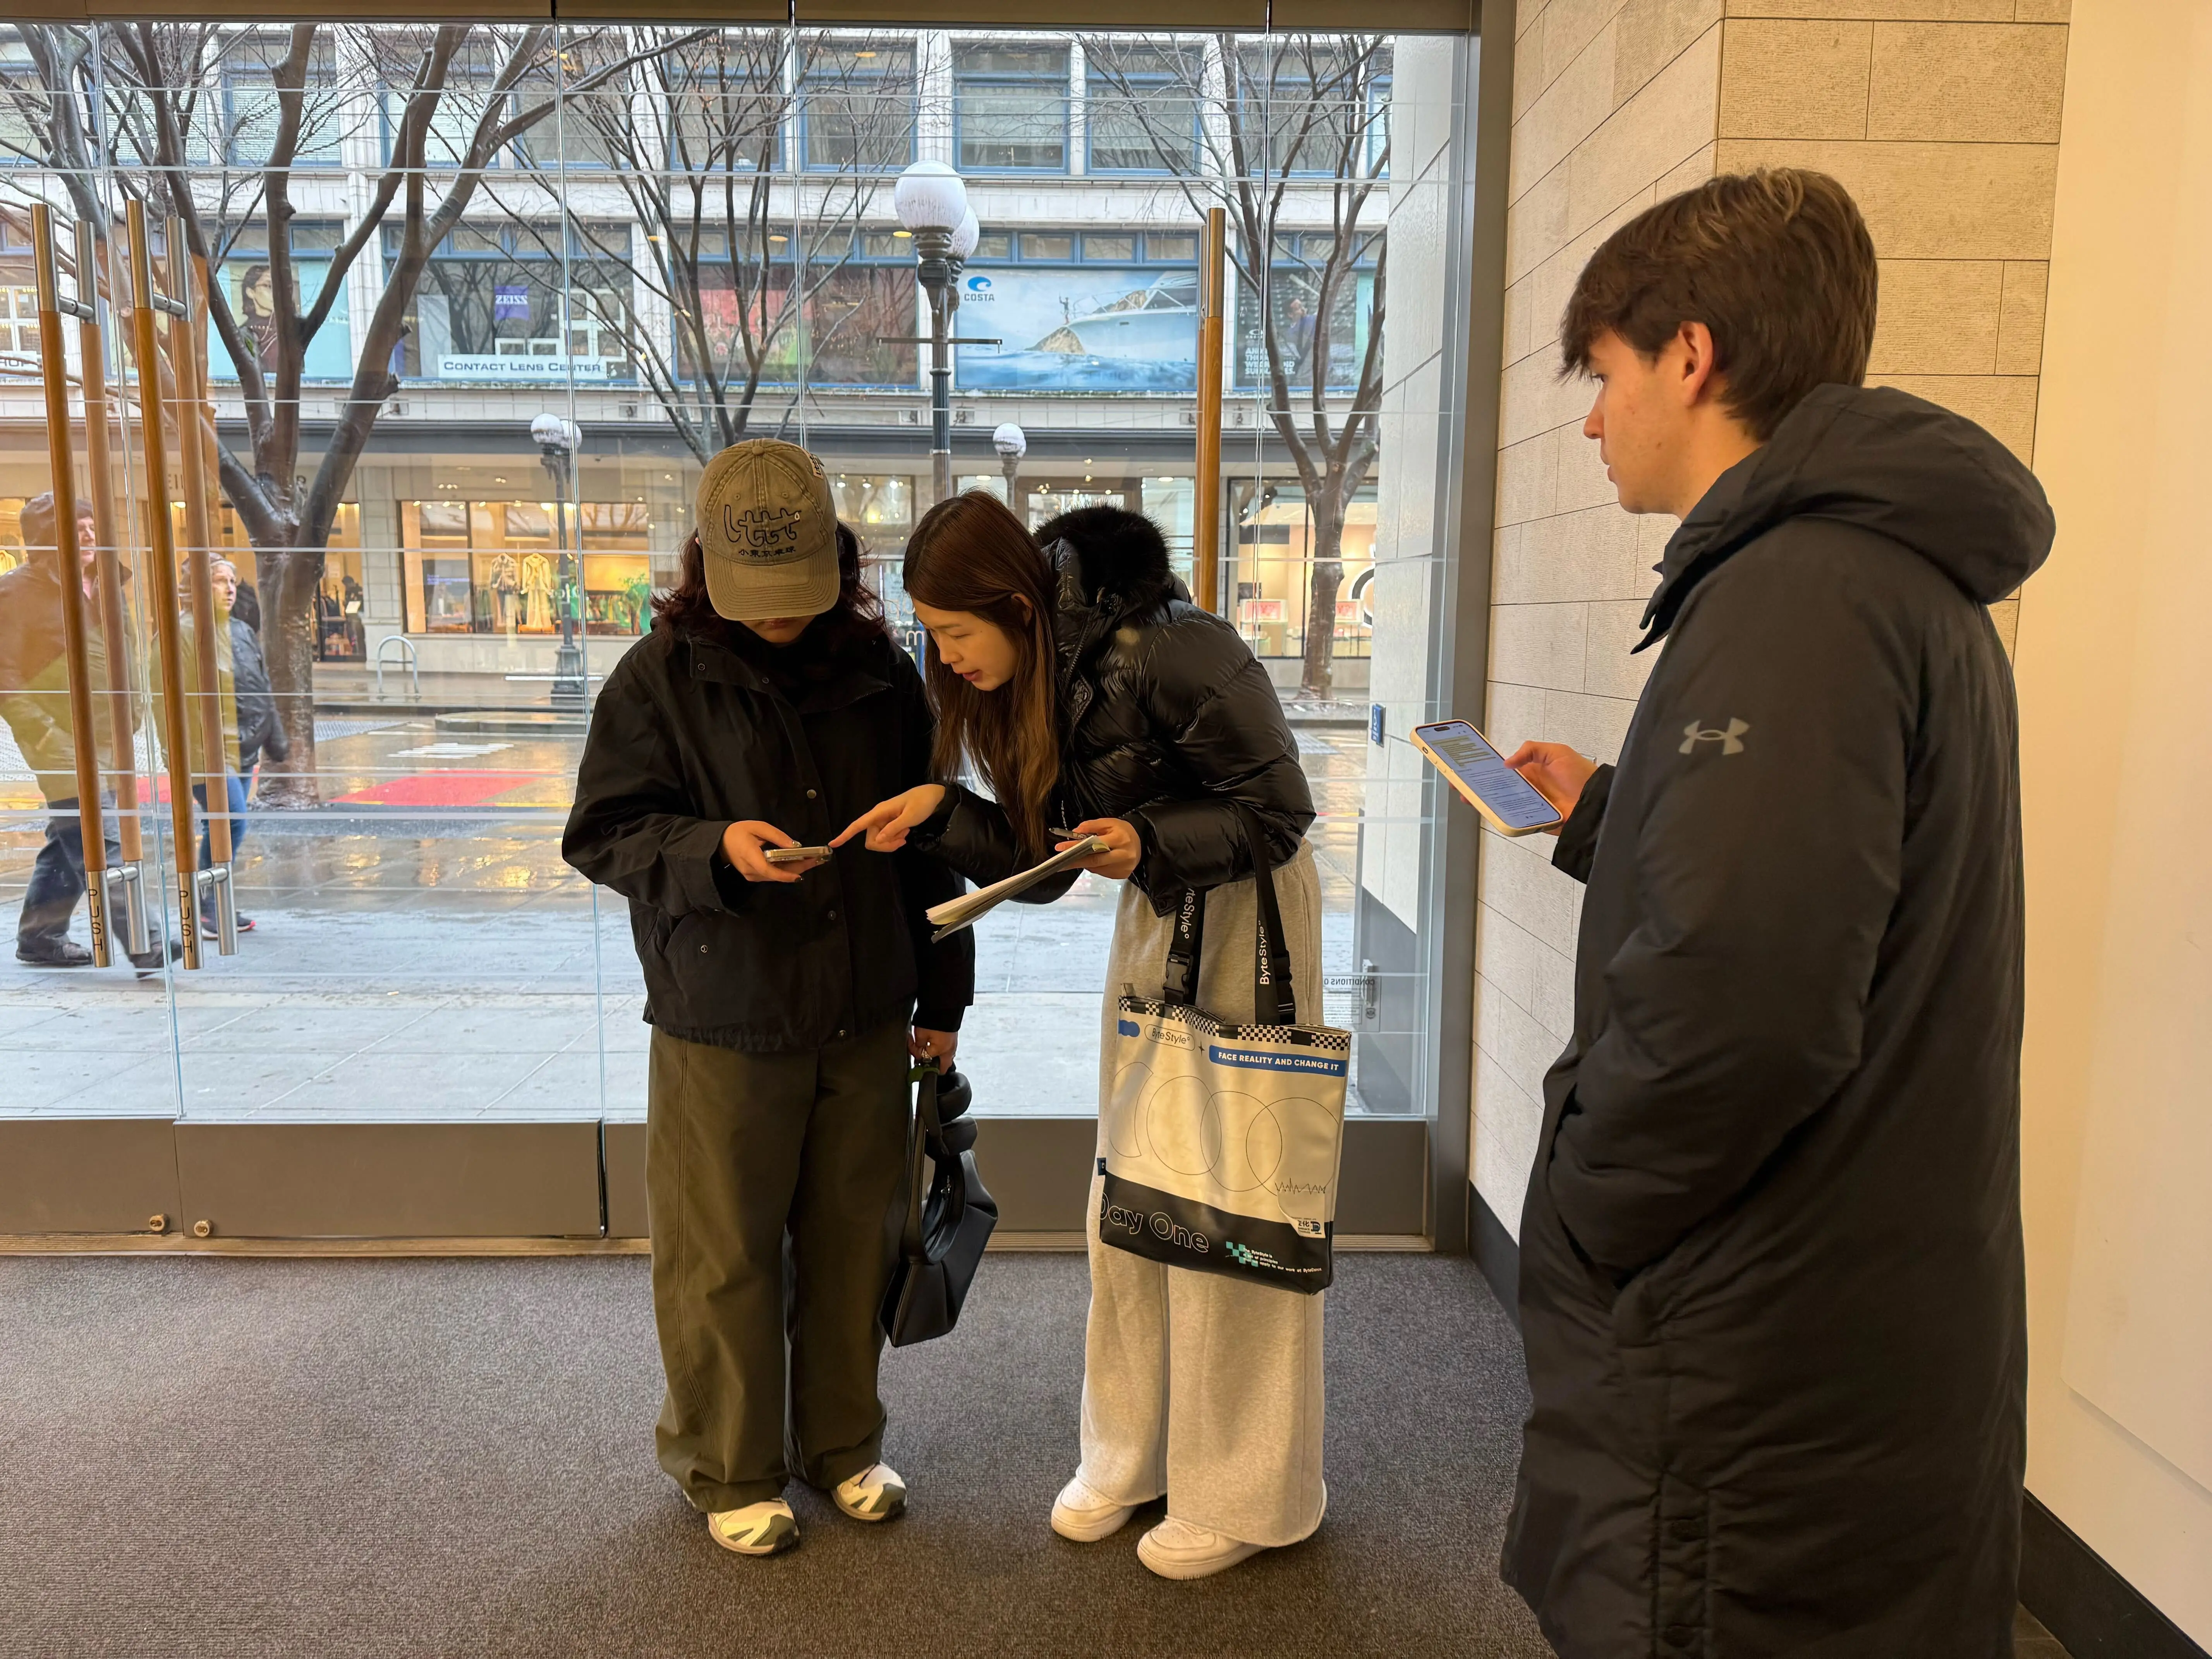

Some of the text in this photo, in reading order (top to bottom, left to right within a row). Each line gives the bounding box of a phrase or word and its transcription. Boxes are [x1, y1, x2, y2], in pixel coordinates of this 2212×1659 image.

[495, 295, 528, 305] ZEISS
[444, 362, 505, 371] CONTACT
[510, 362, 544, 371] LENS
[88, 889, 103, 951] PUSH
[179, 890, 193, 953] PUSH
[1180, 888, 1196, 939] teStyle°
[1218, 1052, 1237, 1061] FACE
[1239, 1054, 1273, 1064] REALITY
[1294, 1059, 1328, 1069] CHANGE
[1149, 1212, 1209, 1253] One
